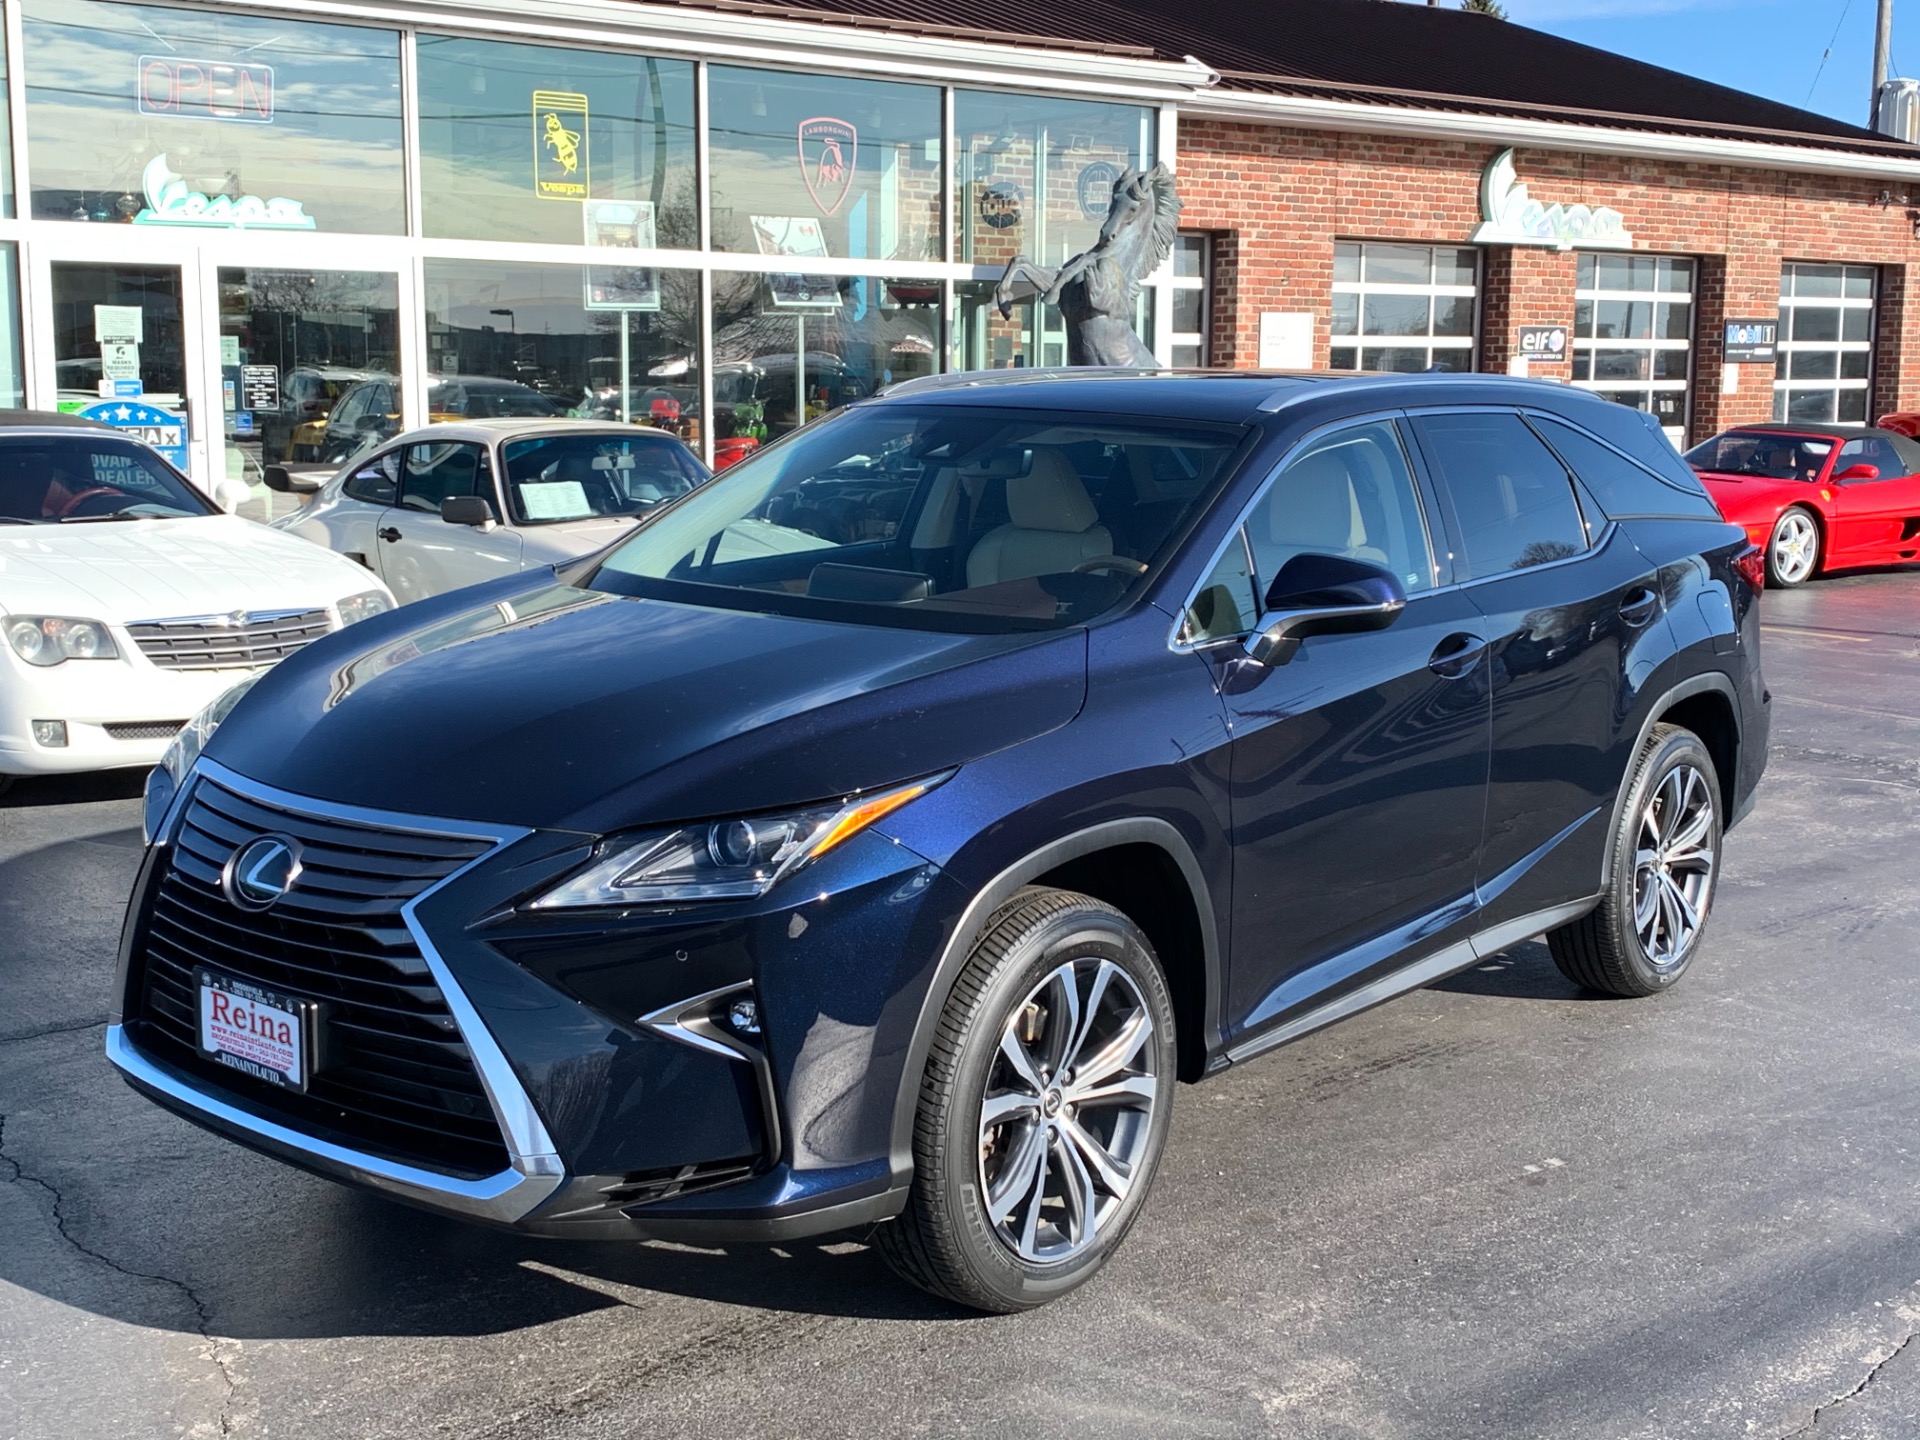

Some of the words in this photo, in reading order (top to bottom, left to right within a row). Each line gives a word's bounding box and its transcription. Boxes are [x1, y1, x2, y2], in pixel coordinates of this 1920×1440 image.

[143, 61, 268, 118] OPEN
[803, 125, 853, 138] LAMBORGHINI
[540, 181, 586, 196] Vespa
[1522, 331, 1550, 350] elf
[1727, 325, 1762, 344] Mobil
[210, 990, 293, 1047] Reina
